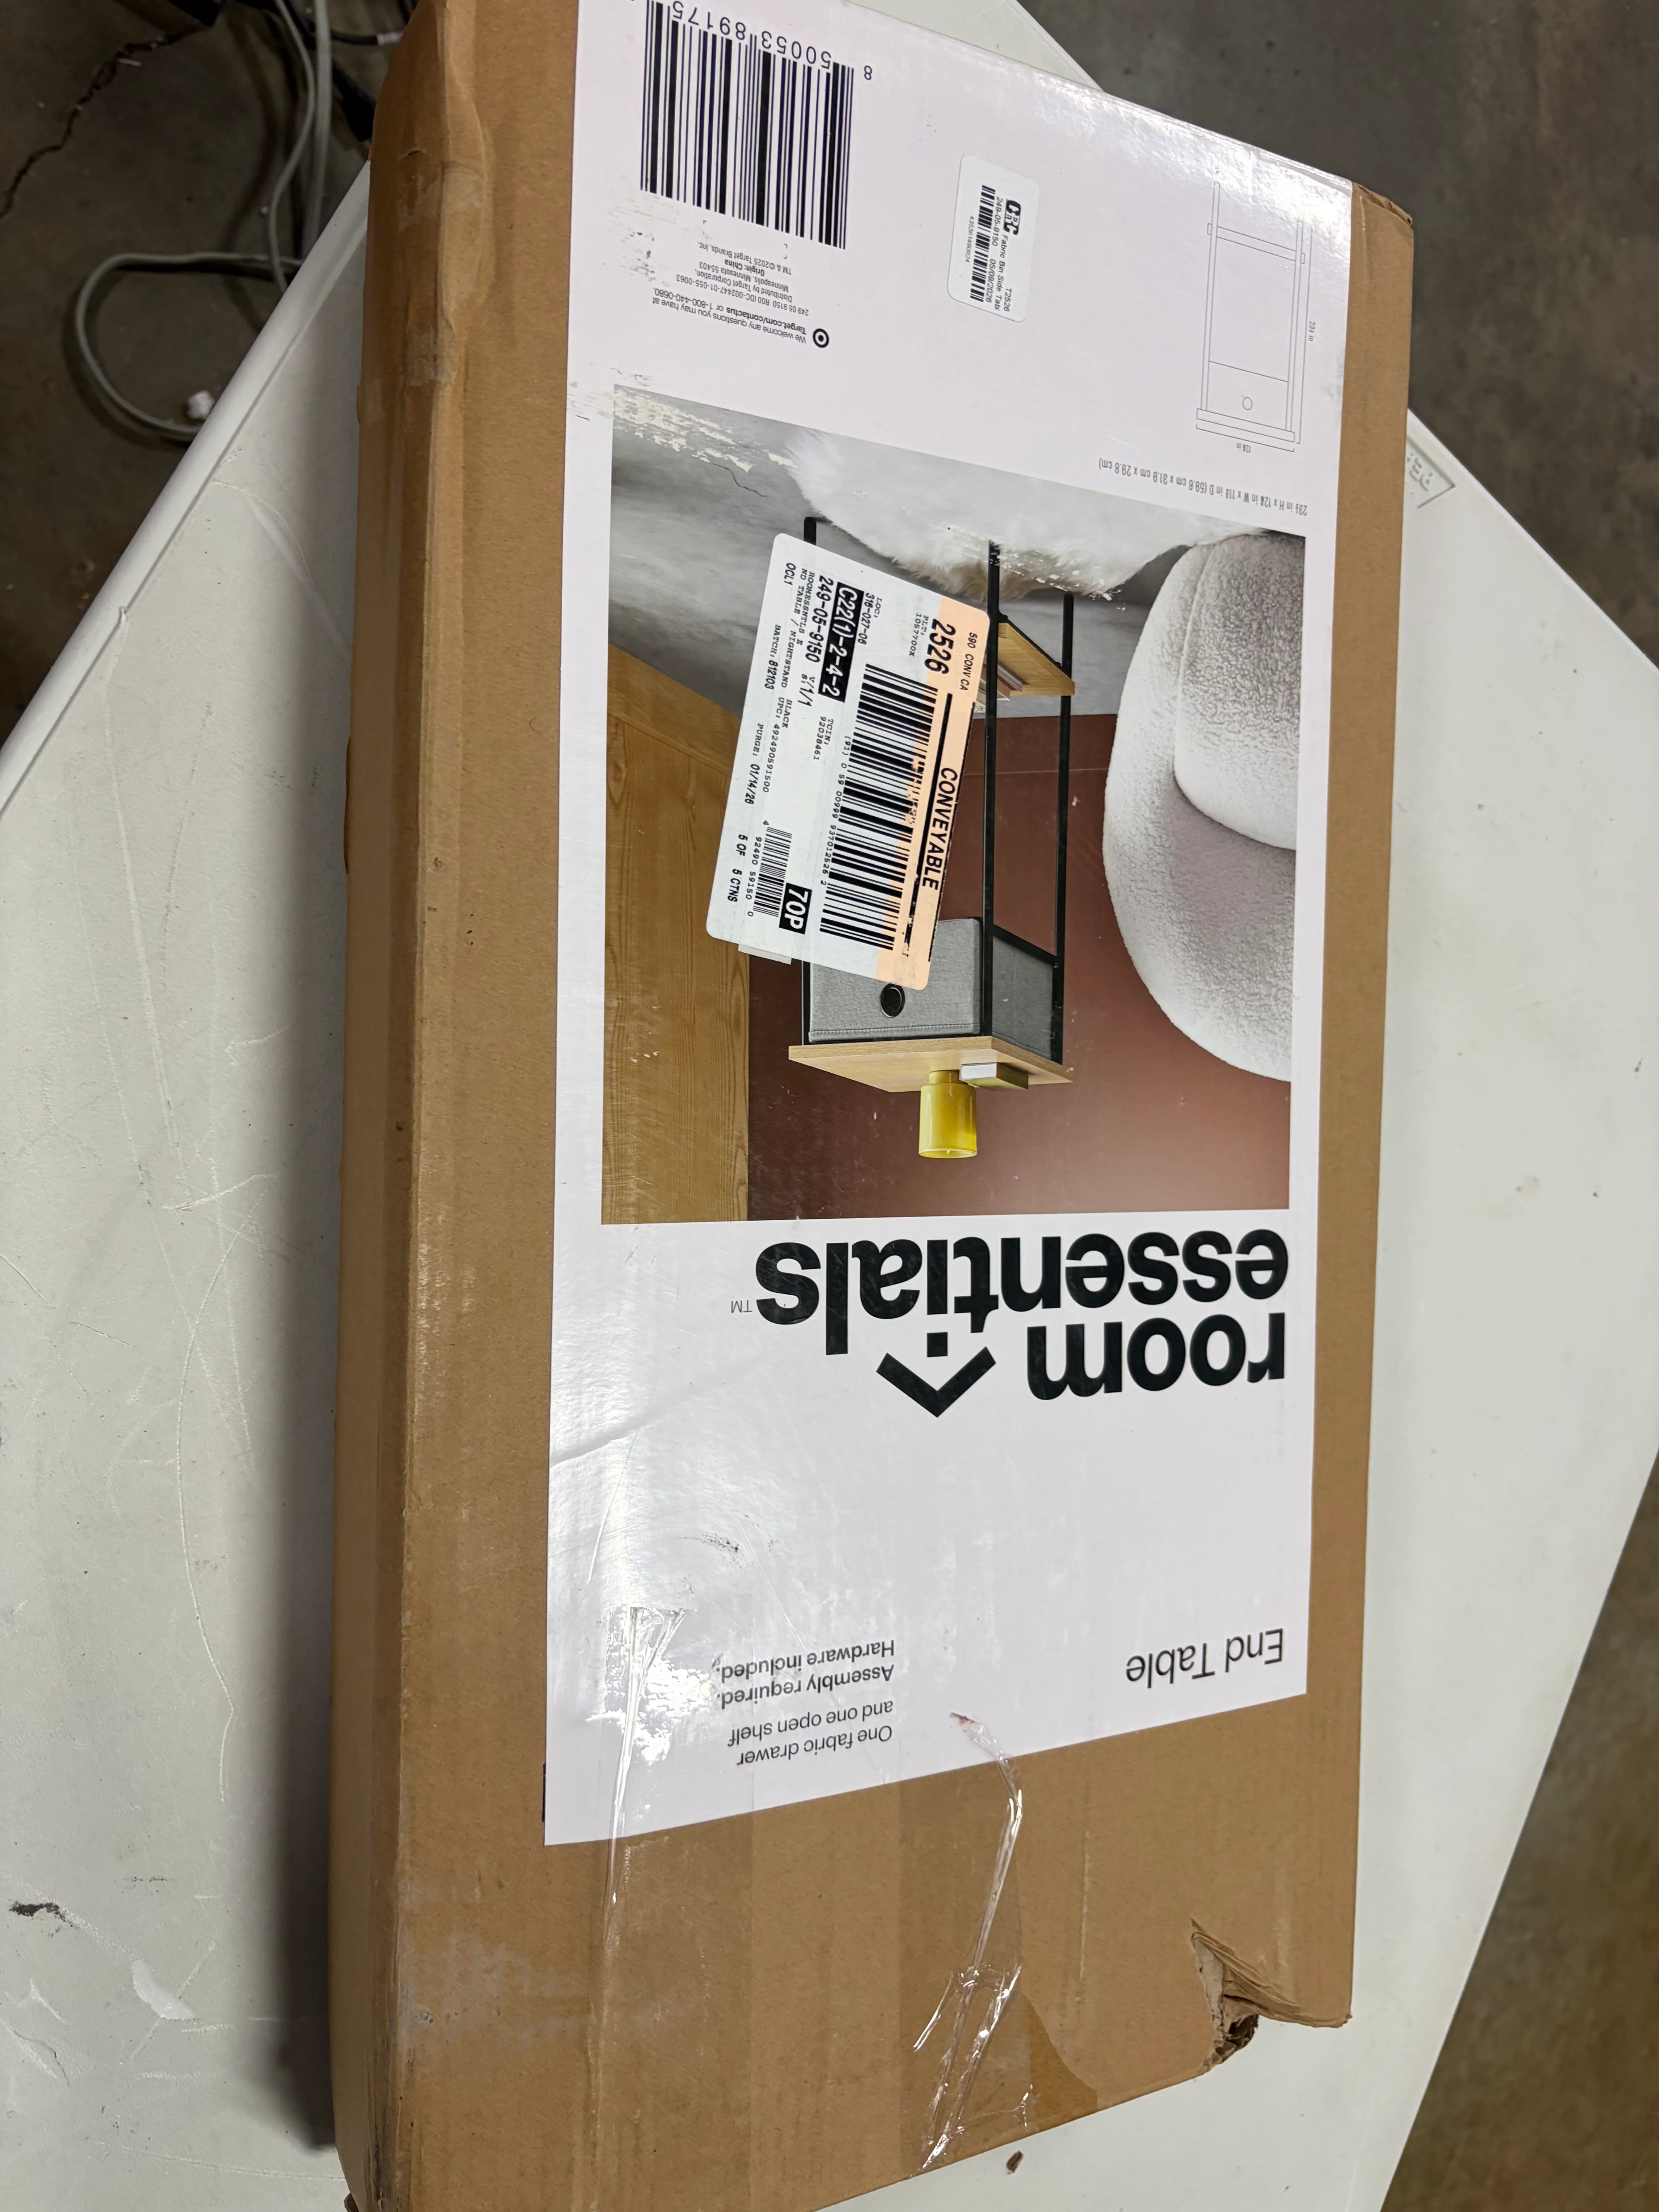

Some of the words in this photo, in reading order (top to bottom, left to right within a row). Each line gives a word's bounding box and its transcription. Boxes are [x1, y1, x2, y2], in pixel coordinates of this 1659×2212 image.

[672, 0, 746, 40] 89175
[761, 30, 831, 69] 50053
[864, 65, 872, 80] 8
[991, 196, 1003, 246] 249-05-9150
[697, 242, 708, 251] Inc.
[709, 244, 732, 258] Brands,
[1000, 234, 1008, 258] Fabric
[699, 261, 719, 273] 55403
[724, 259, 742, 270] China
[733, 252, 752, 264] Target
[694, 269, 731, 286] Corporation,
[720, 267, 750, 282] Minnesota
[744, 264, 764, 276] Origin:
[782, 266, 792, 275] TM
[676, 274, 756, 302] IDC-002447-01-055-0063
[732, 280, 751, 292] Target
[752, 275, 788, 292] Minneapolis,
[752, 284, 759, 294] by
[653, 287, 713, 309] 1-800-440-0680.
[661, 299, 679, 311] have
[761, 288, 792, 303] Distributed
[772, 300, 787, 310] 9150
[1003, 288, 1012, 312] T2526
[680, 303, 696, 314] may
[697, 309, 711, 318] you
[788, 304, 796, 313] 05
[797, 307, 809, 316] 249
[713, 313, 747, 326] questions
[726, 307, 807, 335] Target.com/contactus
[748, 321, 761, 330] any
[762, 326, 793, 339] welcome
[795, 334, 806, 344] We
[1098, 457, 1112, 470] cm)
[1115, 462, 1131, 477] 29.8
[1133, 466, 1137, 475] x
[1140, 468, 1151, 477] cm
[1152, 471, 1167, 485] 31.9
[1170, 475, 1174, 483] x
[1176, 477, 1186, 486] cm
[1188, 479, 1207, 494] (59.6
[1209, 484, 1214, 495] D
[1216, 486, 1223, 497] in
[1243, 492, 1249, 503] W
[1251, 494, 1258, 505] in
[1279, 500, 1284, 510] H
[1286, 501, 1293, 512] in
[800, 568, 807, 580] ND
[794, 585, 804, 614] TABLE
[799, 571, 815, 634] ROOMESSNTLS
[873, 597, 882, 618] LOC:
[805, 575, 834, 663] 249-05-9150
[857, 592, 875, 645] 316-027-06
[920, 615, 929, 635] PLT:
[769, 624, 781, 657] BATCH:
[822, 587, 857, 696] C22(1)-2-4-2
[908, 613, 922, 657] 1057700X
[967, 632, 977, 649] 590
[924, 618, 956, 674] 2526
[781, 630, 796, 688] NIGHTSTAND
[962, 653, 974, 678] CONV
[764, 659, 778, 690] 812103
[959, 678, 970, 690] CA
[797, 687, 814, 707] 1/1
[775, 697, 785, 718] UPC:
[781, 699, 792, 728] BLACK
[752, 723, 764, 756] PURGE:
[813, 716, 826, 760] 92038461
[823, 718, 834, 745] TCIN:
[842, 736, 851, 756] (91)
[762, 724, 780, 793] 492490591500
[838, 774, 845, 785] 59
[831, 791, 842, 819] 00999
[922, 768, 958, 890] CONVEYABLE
[735, 843, 746, 856] OF
[751, 836, 762, 865] 92490
[822, 824, 836, 874] 937012526
[727, 878, 740, 902] CTNS
[745, 871, 756, 900] 59150
[755, 1229, 1288, 1357] essentials
[1027, 1312, 1285, 1400] room
[806, 1640, 894, 1665] Hardware
[1224, 1628, 1283, 1673] End
[716, 1654, 801, 1683] included.
[1126, 1643, 1215, 1688] Table
[806, 1664, 894, 1693] Assembly
[716, 1680, 801, 1710] required.
[826, 1707, 857, 1723] one
[862, 1700, 893, 1722] and
[778, 1711, 821, 1732] open
[727, 1723, 772, 1747] shelf
[804, 1732, 853, 1755] fabric
[857, 1725, 892, 1742] One
[736, 1742, 799, 1765] drawer
